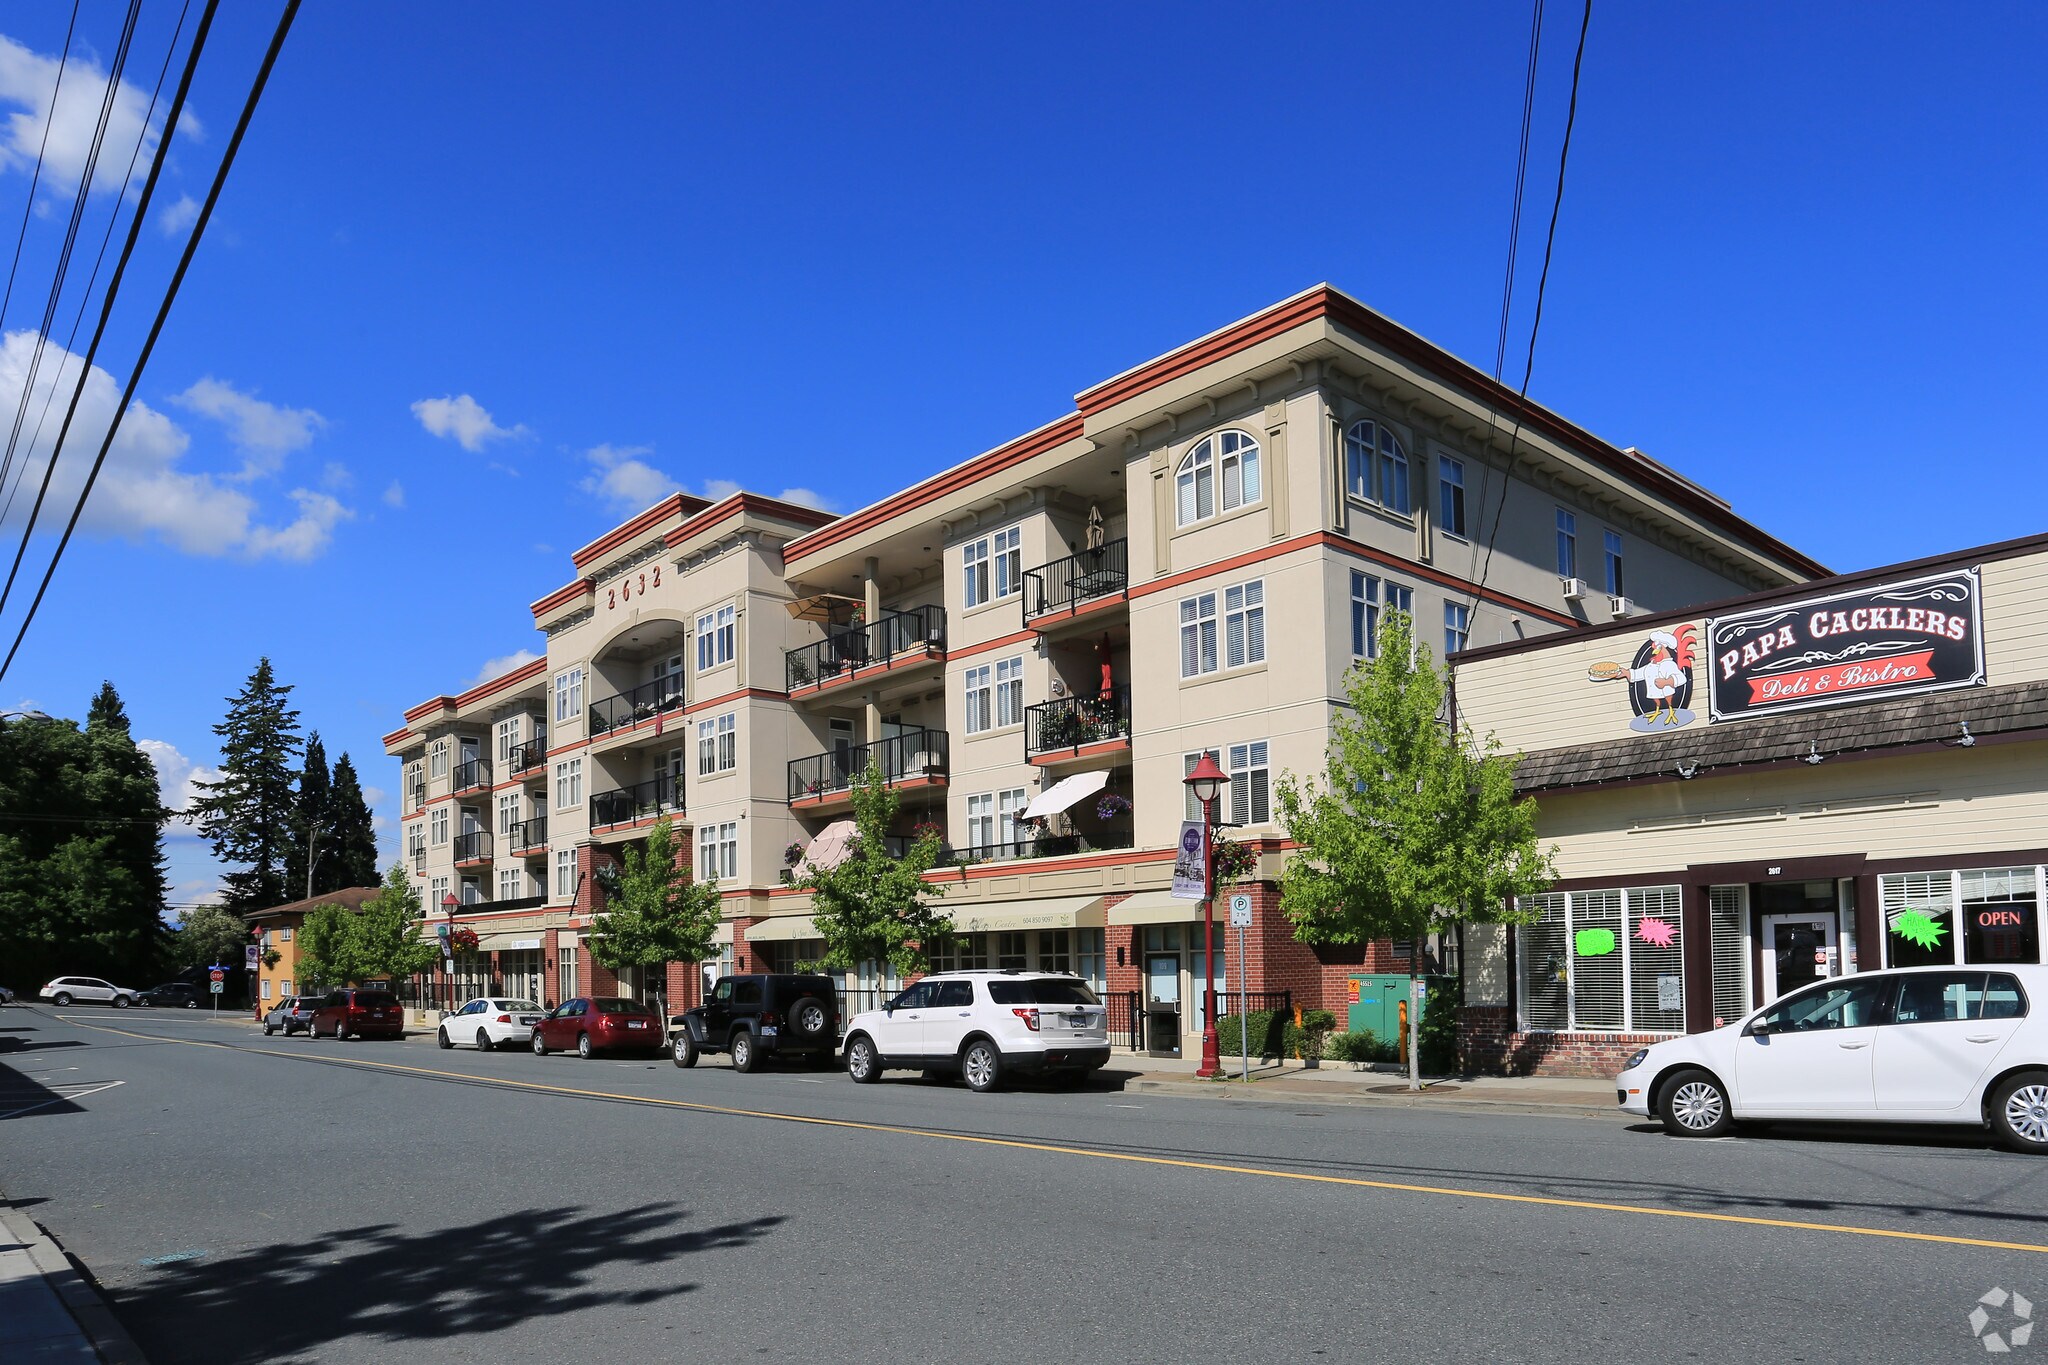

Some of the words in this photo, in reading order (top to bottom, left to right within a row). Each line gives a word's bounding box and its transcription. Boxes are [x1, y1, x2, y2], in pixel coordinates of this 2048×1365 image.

[608, 566, 661, 610] 2632
[1719, 625, 1797, 681] PAPA
[1809, 607, 1967, 641] CACKLERS
[1762, 677, 1809, 699] Deli
[1814, 674, 1831, 691] &
[1837, 662, 1918, 687] Bistro
[1768, 867, 1781, 875] 2617
[1238, 900, 1244, 908] P
[1042, 916, 1054, 924] 9097
[1978, 911, 2021, 926] OPEN
